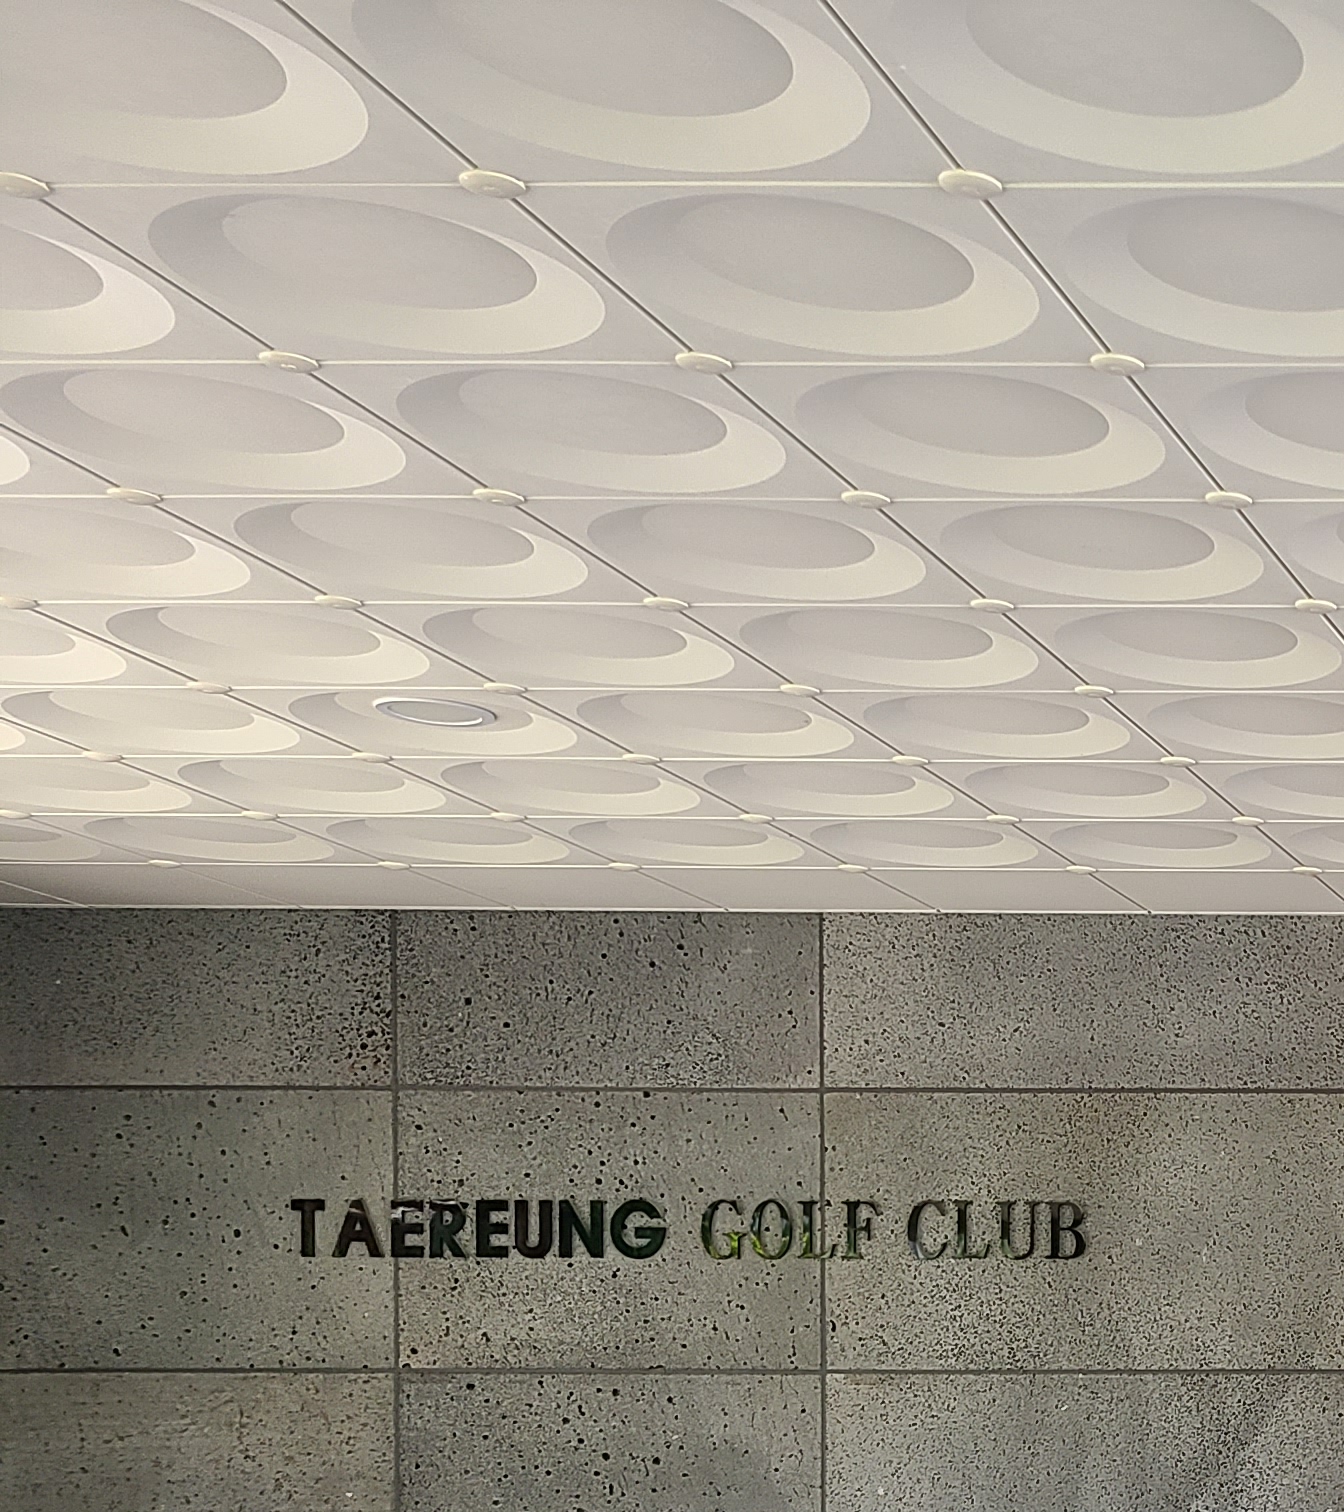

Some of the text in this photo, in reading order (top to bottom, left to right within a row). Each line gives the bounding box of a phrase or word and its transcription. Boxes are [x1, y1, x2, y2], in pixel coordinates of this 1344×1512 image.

[291, 1198, 1088, 1260] TAEREUNG GOLF CLUB
